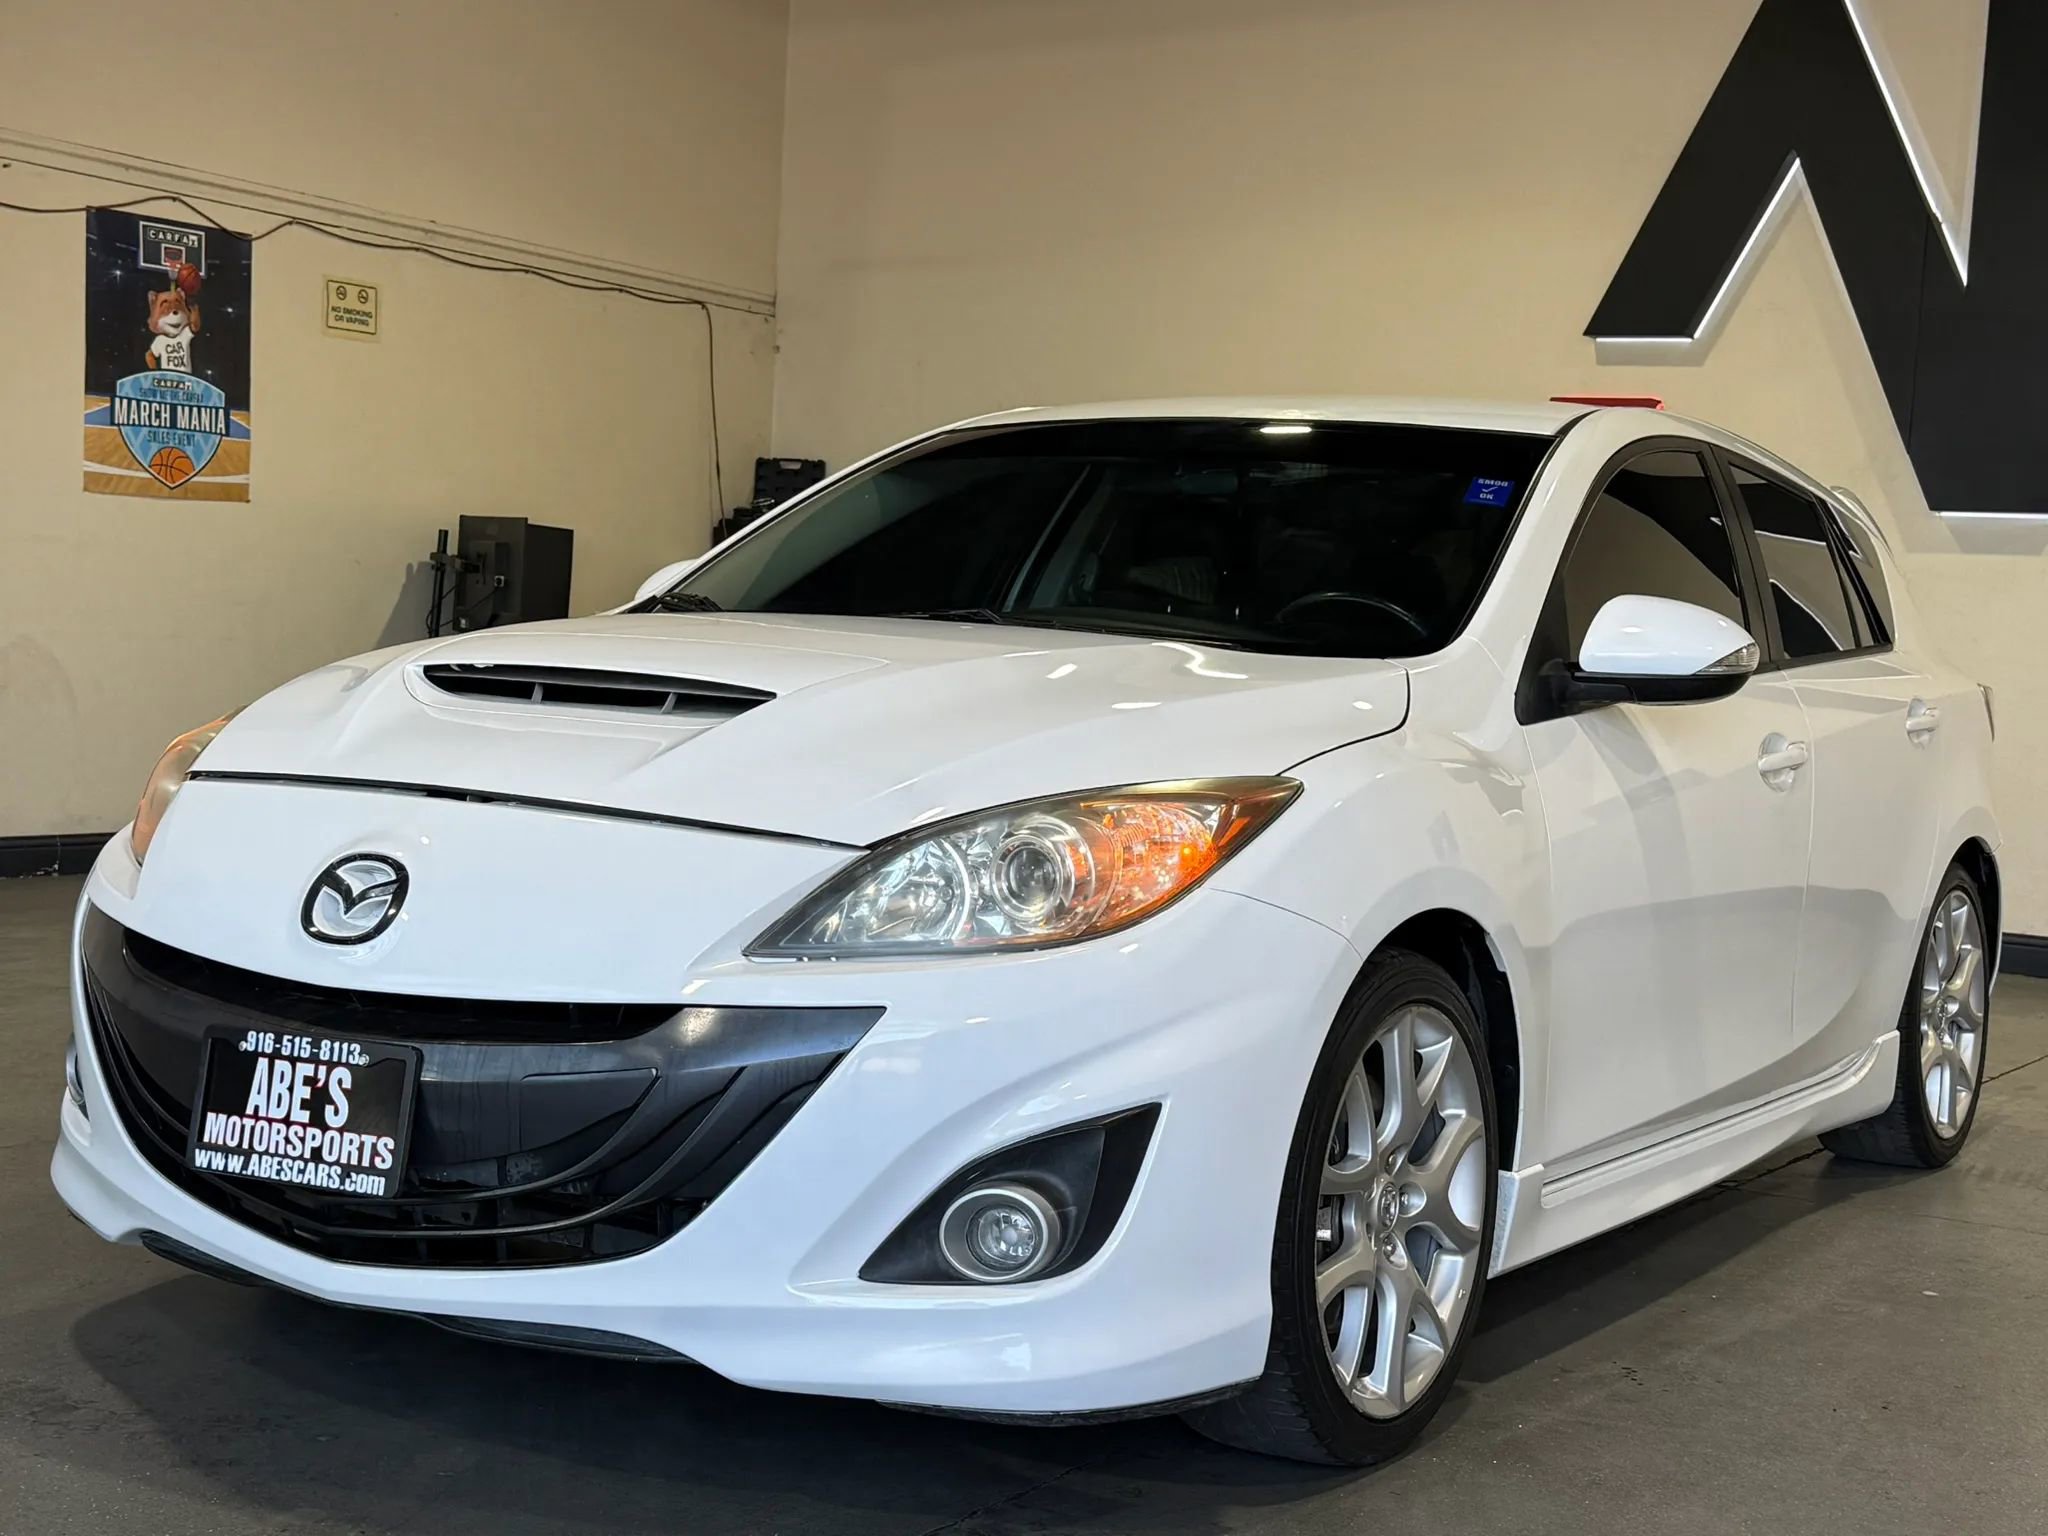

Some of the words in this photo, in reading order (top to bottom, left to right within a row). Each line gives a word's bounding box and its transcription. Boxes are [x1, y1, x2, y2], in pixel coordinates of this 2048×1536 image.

[149, 229, 198, 247] CARFAX
[166, 341, 185, 354] CAR
[167, 355, 186, 368] FOX
[115, 397, 170, 427] MARCH
[177, 405, 226, 434] MANIA
[247, 1031, 361, 1065] 916-515-8113
[245, 1056, 352, 1128] ABE'S
[203, 1111, 395, 1170] MOTORSPORTS
